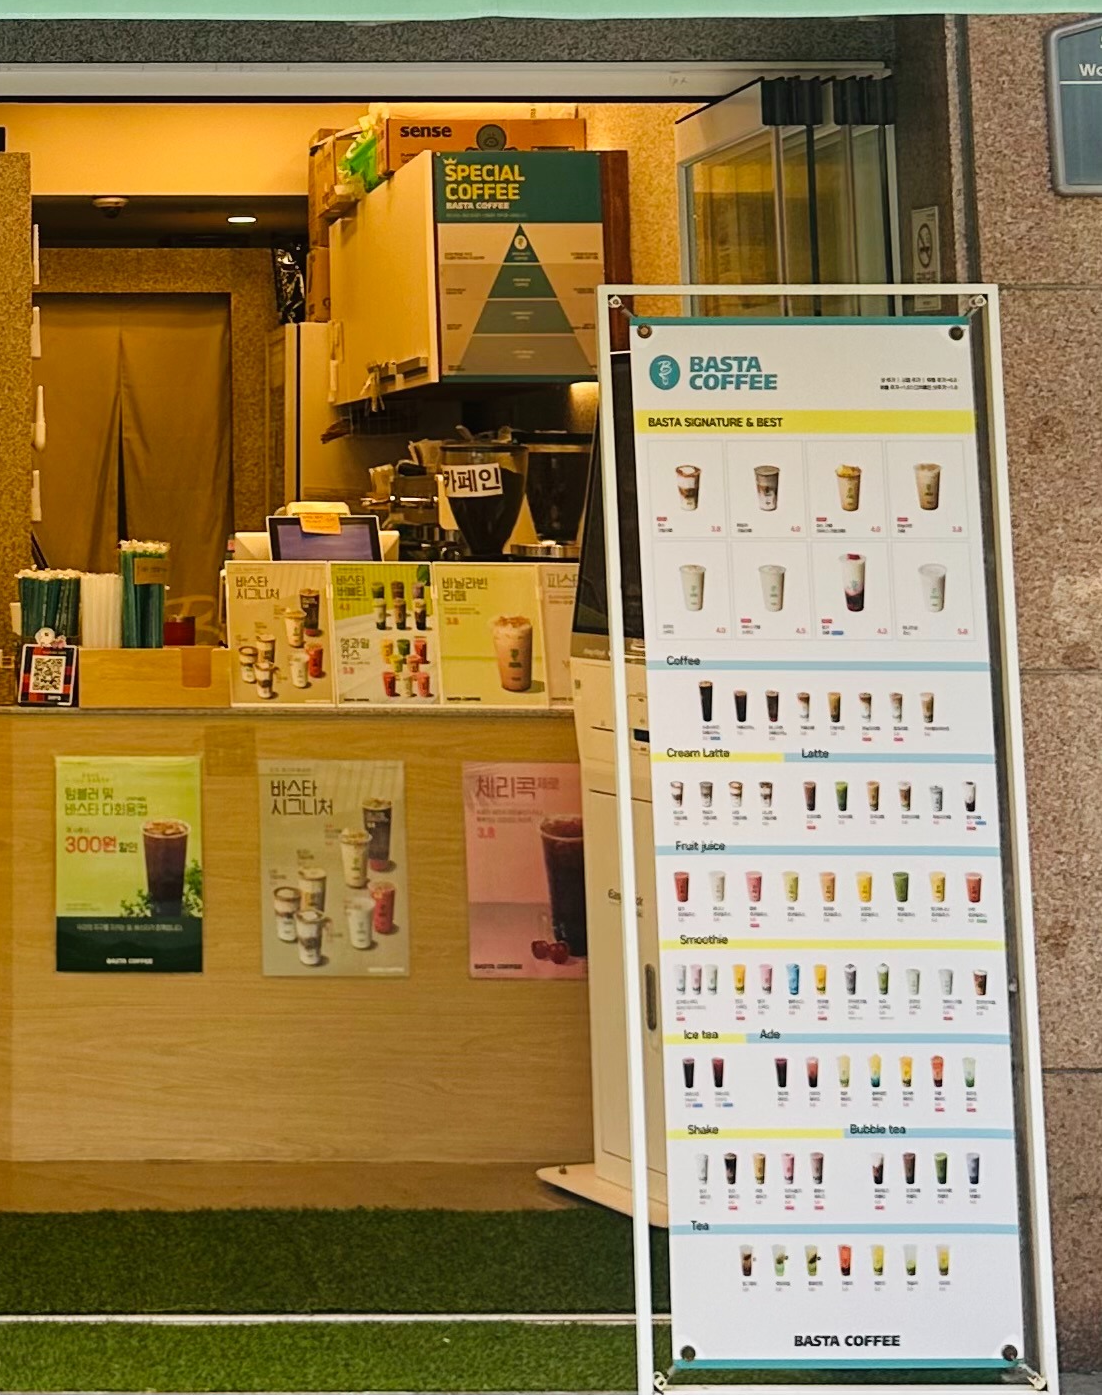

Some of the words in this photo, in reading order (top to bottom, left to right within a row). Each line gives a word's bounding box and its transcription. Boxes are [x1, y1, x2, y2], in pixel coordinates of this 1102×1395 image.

[400, 125, 452, 138] sense
[444, 164, 526, 181] SPECIAL
[445, 183, 520, 200] COFFEE
[689, 356, 762, 373] BASTA
[689, 374, 778, 390] COFFEE
[648, 417, 682, 427] BASTA
[684, 417, 743, 427] SIGNATURE
[746, 417, 754, 427] &
[756, 417, 783, 427] BEST
[236, 576, 269, 588] 바스타
[236, 588, 280, 600] 시그니처
[666, 655, 701, 666] Coffee
[666, 747, 701, 759] Cream
[702, 747, 730, 759] Latte
[801, 748, 829, 759] Latte
[270, 780, 318, 797] 바스타
[476, 775, 536, 800] 체리콕
[271, 798, 334, 816] 시그니처
[65, 835, 117, 854] 300원
[675, 840, 699, 852] Fruit
[701, 841, 726, 854] juice
[680, 934, 729, 946] Smoothie
[683, 1029, 699, 1040] Ice
[701, 1030, 719, 1040] tea
[759, 1029, 780, 1040] Ade
[687, 1124, 719, 1135] Shake
[850, 1123, 886, 1134] Bubble
[888, 1124, 906, 1135] tea
[691, 1220, 709, 1232] Tea
[794, 1335, 840, 1347] BASTA
[844, 1335, 901, 1347] COFFEE
